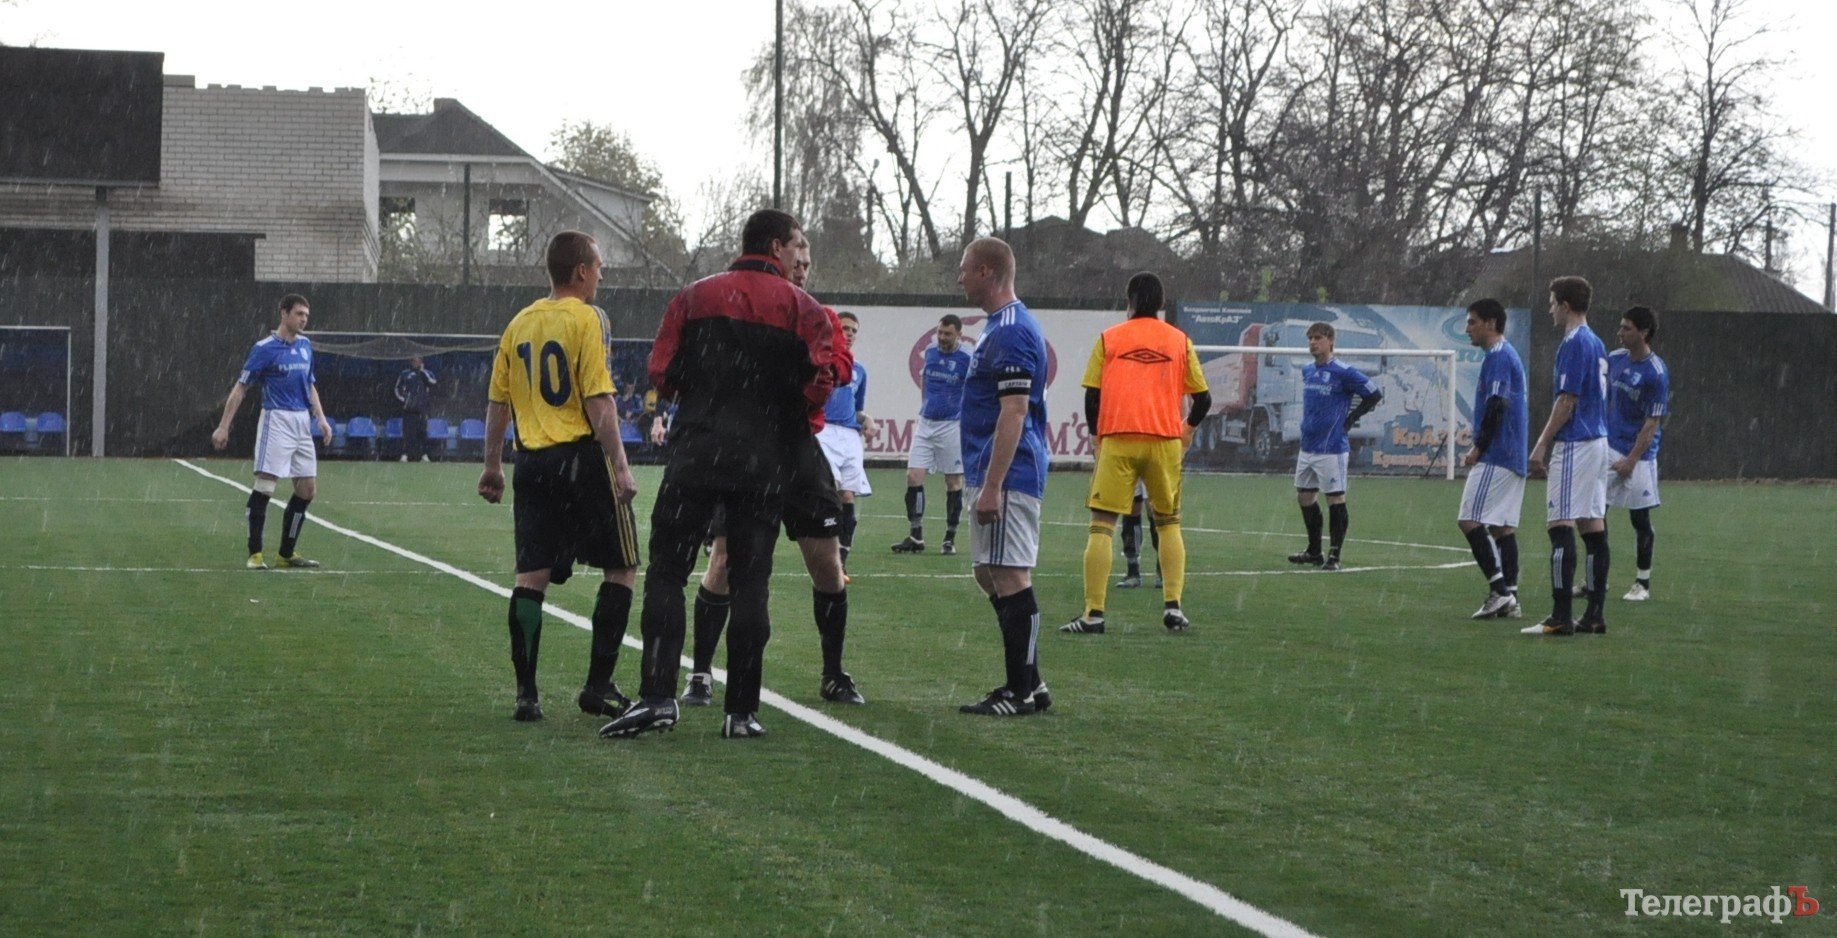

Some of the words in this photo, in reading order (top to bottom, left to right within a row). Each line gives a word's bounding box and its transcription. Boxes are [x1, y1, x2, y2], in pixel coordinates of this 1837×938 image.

[516, 340, 572, 407] 10
[860, 419, 919, 453] ЕМ
[1044, 411, 1095, 456] М'Я
